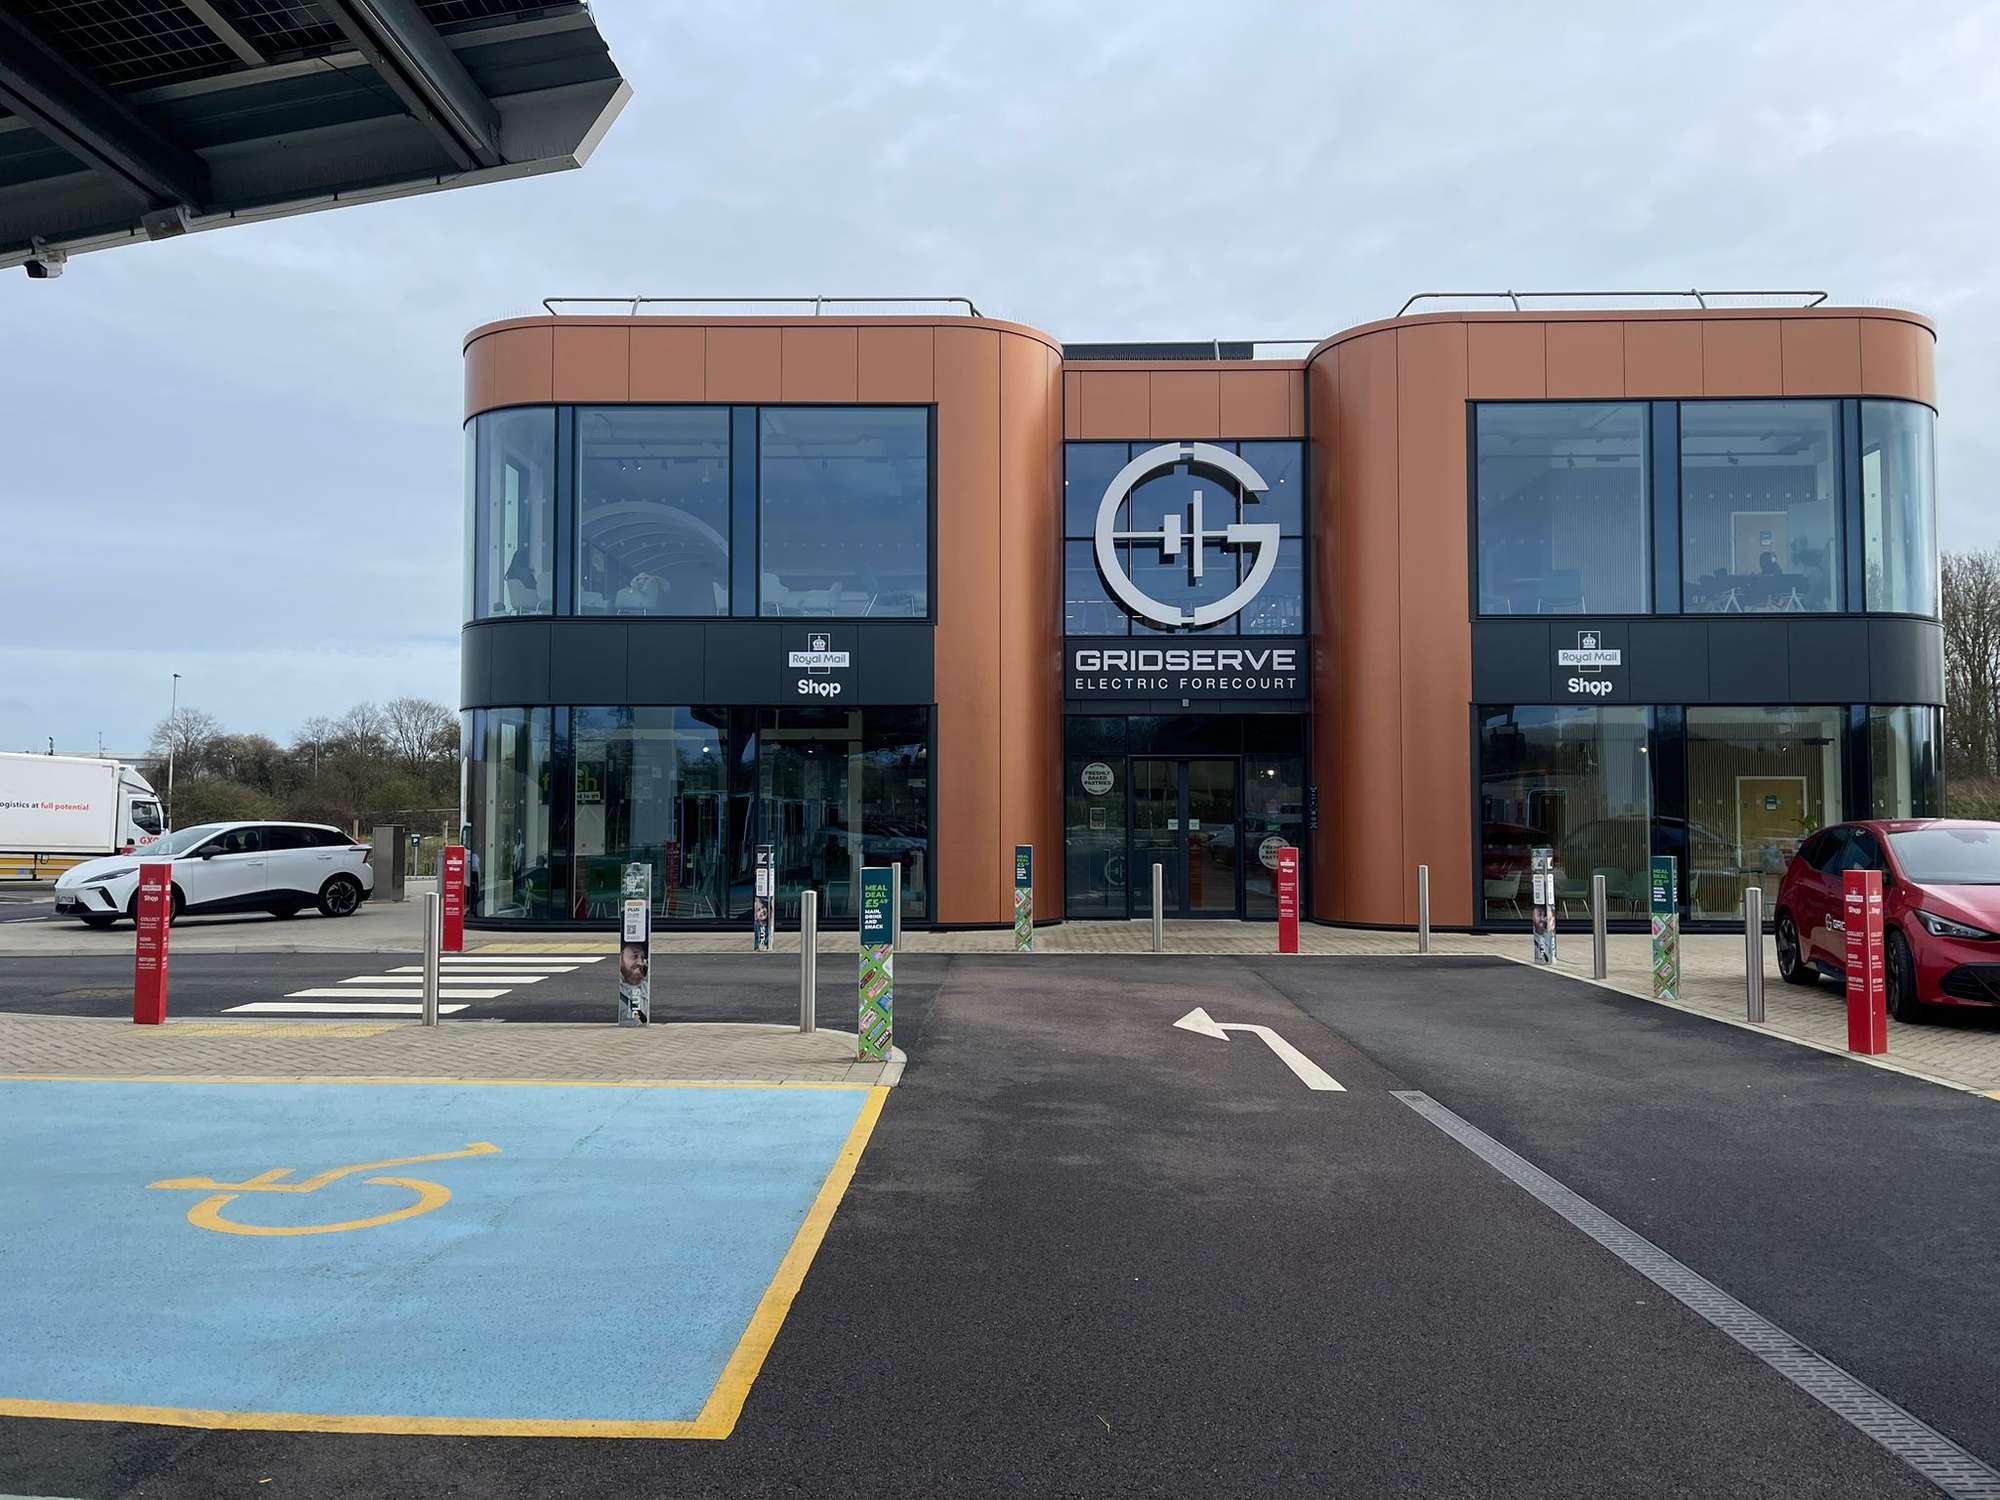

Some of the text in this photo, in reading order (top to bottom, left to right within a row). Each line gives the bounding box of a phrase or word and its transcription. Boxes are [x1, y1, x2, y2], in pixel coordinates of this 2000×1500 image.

[792, 653, 847, 665] Royal Mail
[1075, 649, 1297, 671] GRIDSERVE
[1562, 651, 1618, 664] Royal Mail
[797, 678, 842, 698] Shop
[1075, 677, 1297, 690] ELECTRIC FORECOURT
[1567, 676, 1613, 697] Shop
[40, 801, 54, 809] full
[55, 803, 89, 811] potential
[144, 894, 159, 902] Shop
